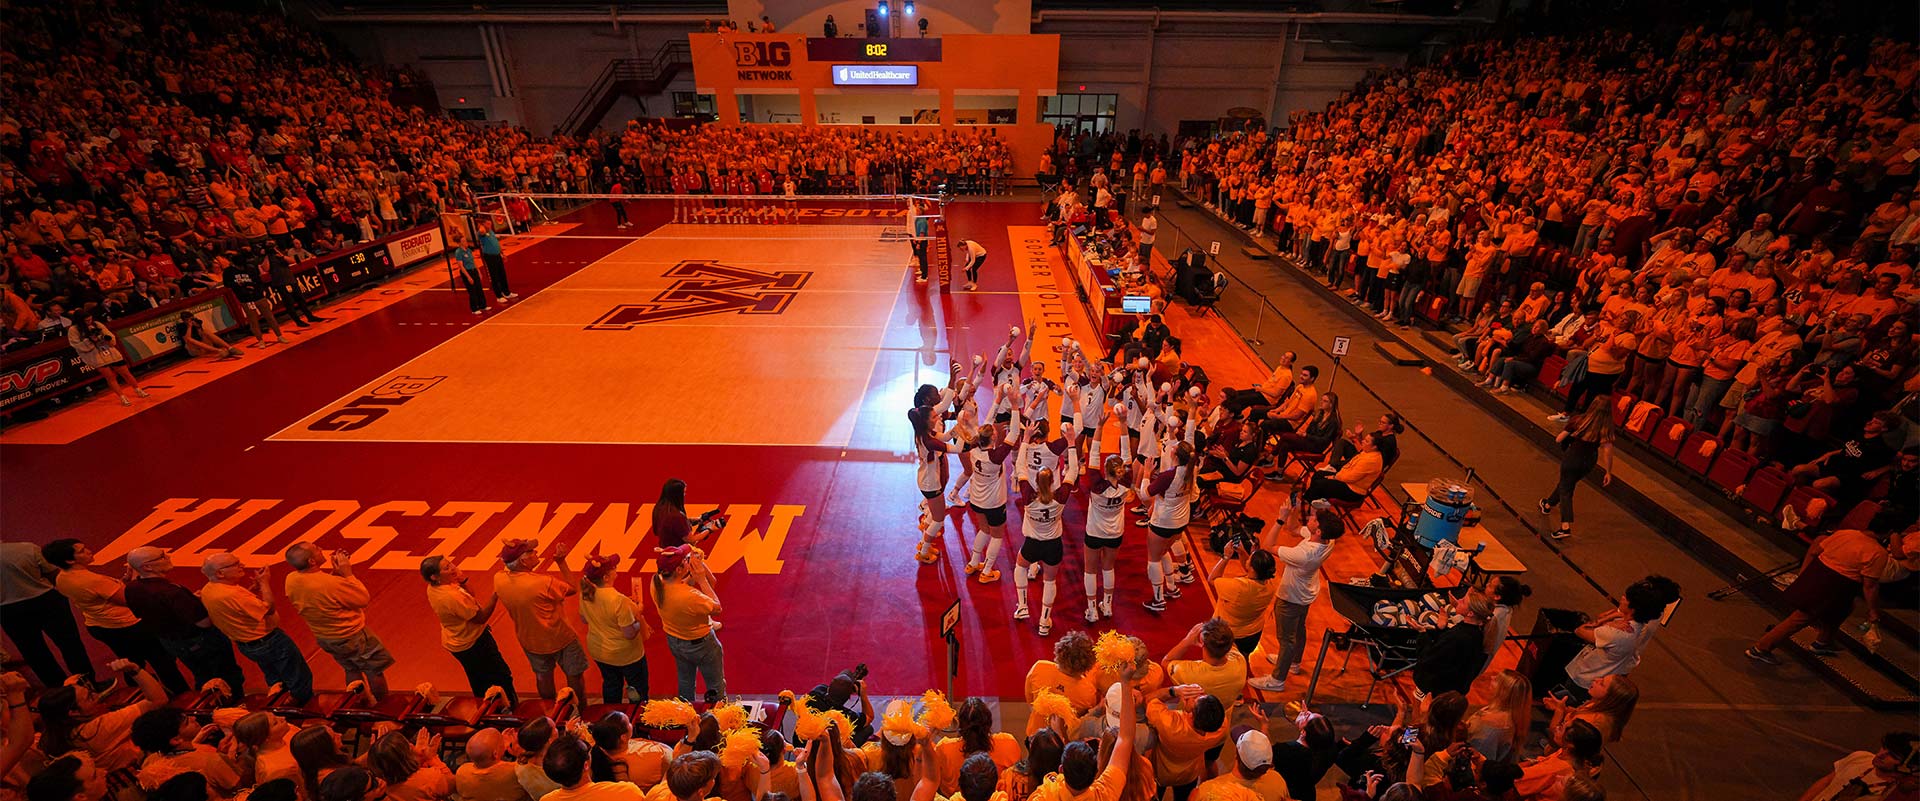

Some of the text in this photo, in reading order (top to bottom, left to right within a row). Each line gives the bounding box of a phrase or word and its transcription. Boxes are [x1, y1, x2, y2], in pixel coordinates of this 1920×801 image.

[866, 44, 888, 57] 8:02
[737, 70, 793, 82] NETWORK
[850, 70, 911, 81] UnitedHealthcare
[400, 233, 432, 252] FEDERATED
[350, 252, 366, 265] 1:30
[936, 236, 950, 287] MINNESOTA
[1024, 238, 1052, 276] GOPHER
[1033, 451, 1042, 465] 5
[975, 459, 983, 473] 4
